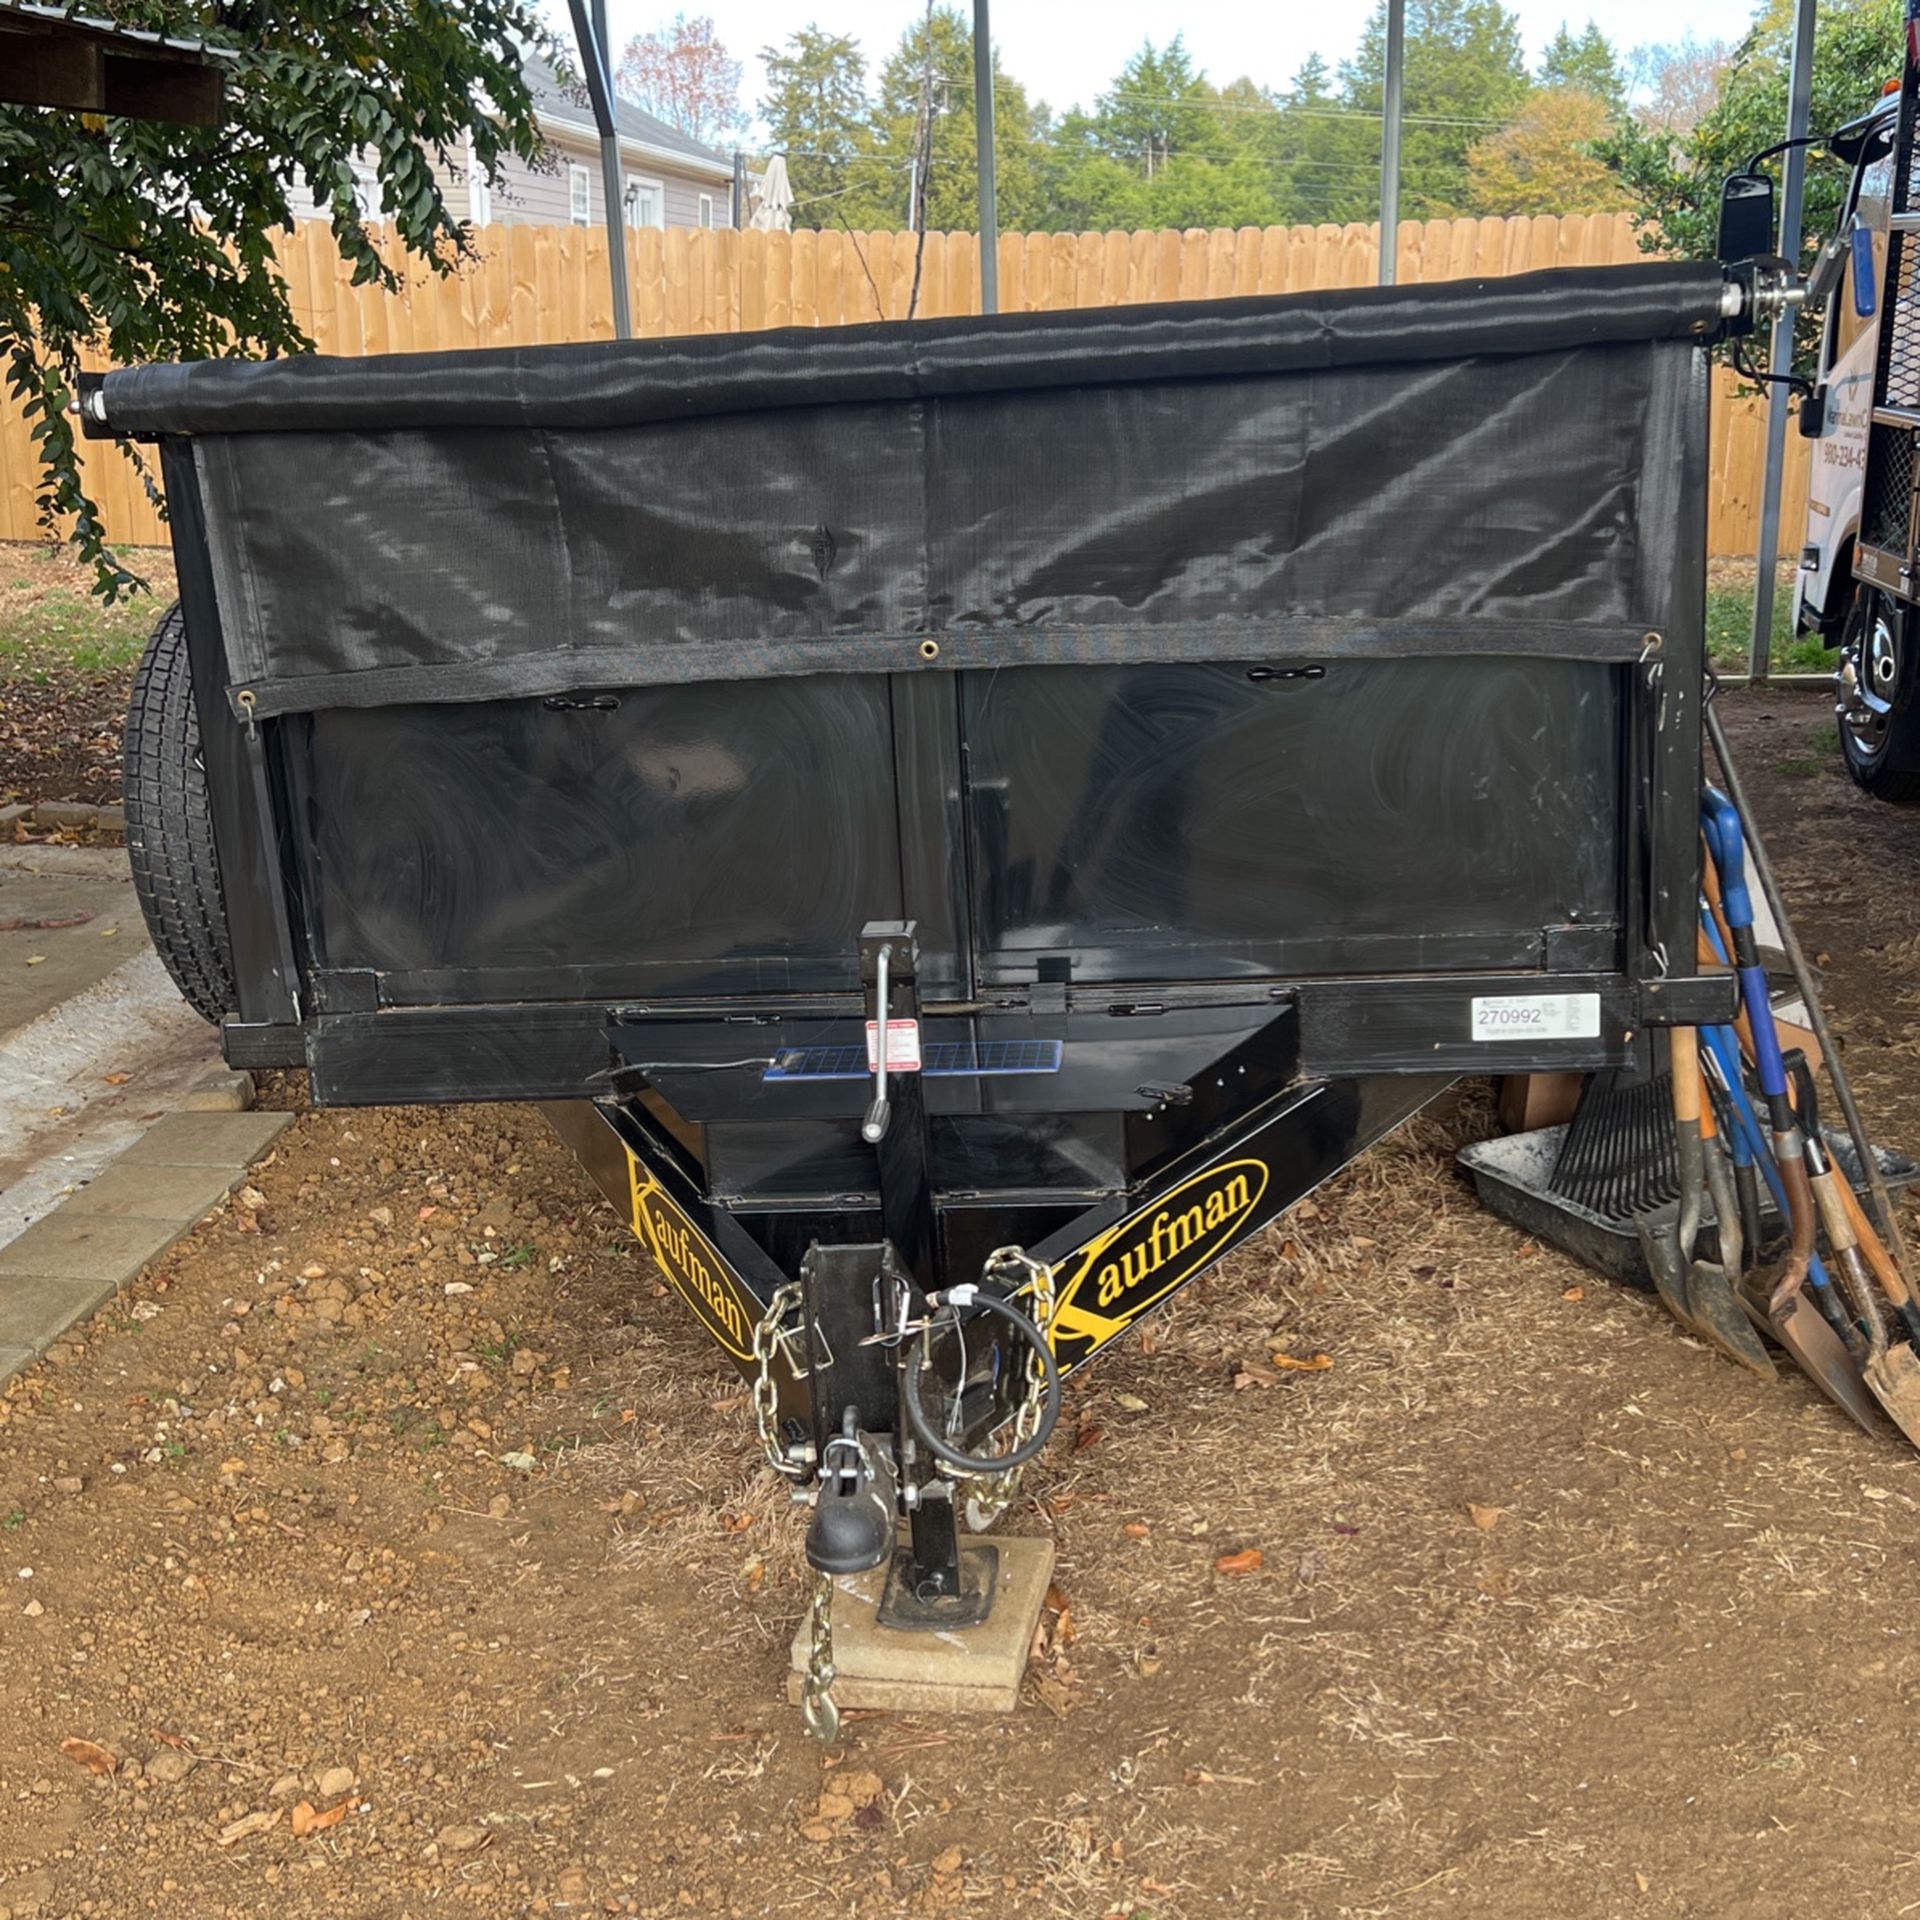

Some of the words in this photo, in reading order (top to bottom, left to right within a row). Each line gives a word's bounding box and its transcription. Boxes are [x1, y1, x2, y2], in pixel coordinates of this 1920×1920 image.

[1479, 1009, 1542, 1025] 270992
[621, 1139, 745, 1348] Kaufman
[1020, 1173, 1251, 1386] Kaufman
